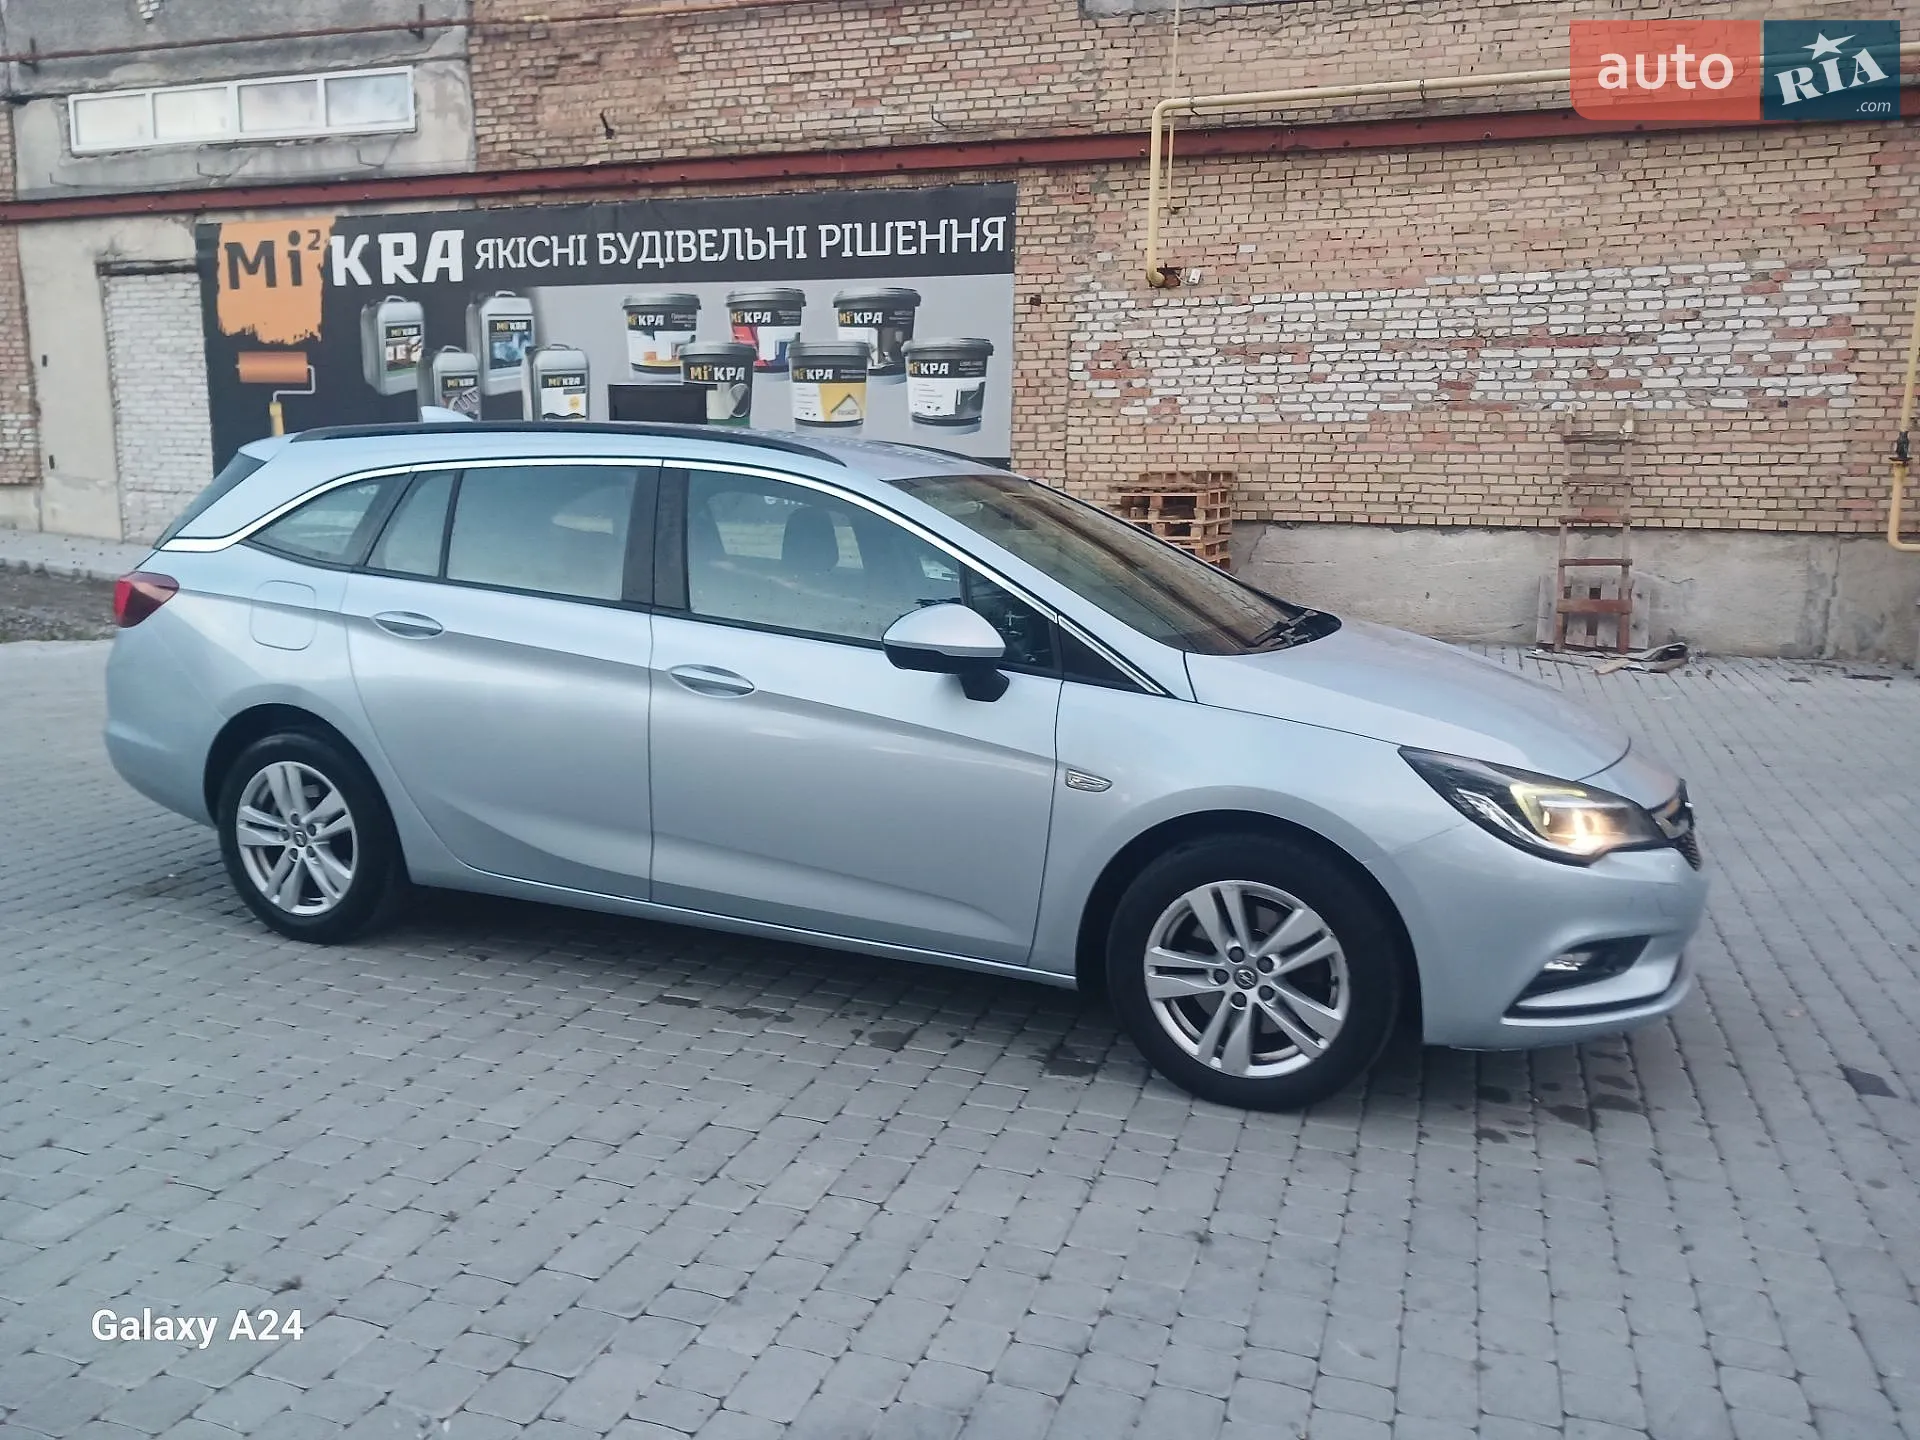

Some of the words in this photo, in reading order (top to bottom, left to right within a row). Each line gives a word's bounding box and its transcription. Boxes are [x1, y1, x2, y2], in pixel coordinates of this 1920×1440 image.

[475, 234, 588, 270] ЯКІСНІ
[597, 224, 808, 268] БУДІВЕЛЬНІ
[818, 215, 1007, 258] РІШЕННЯ
